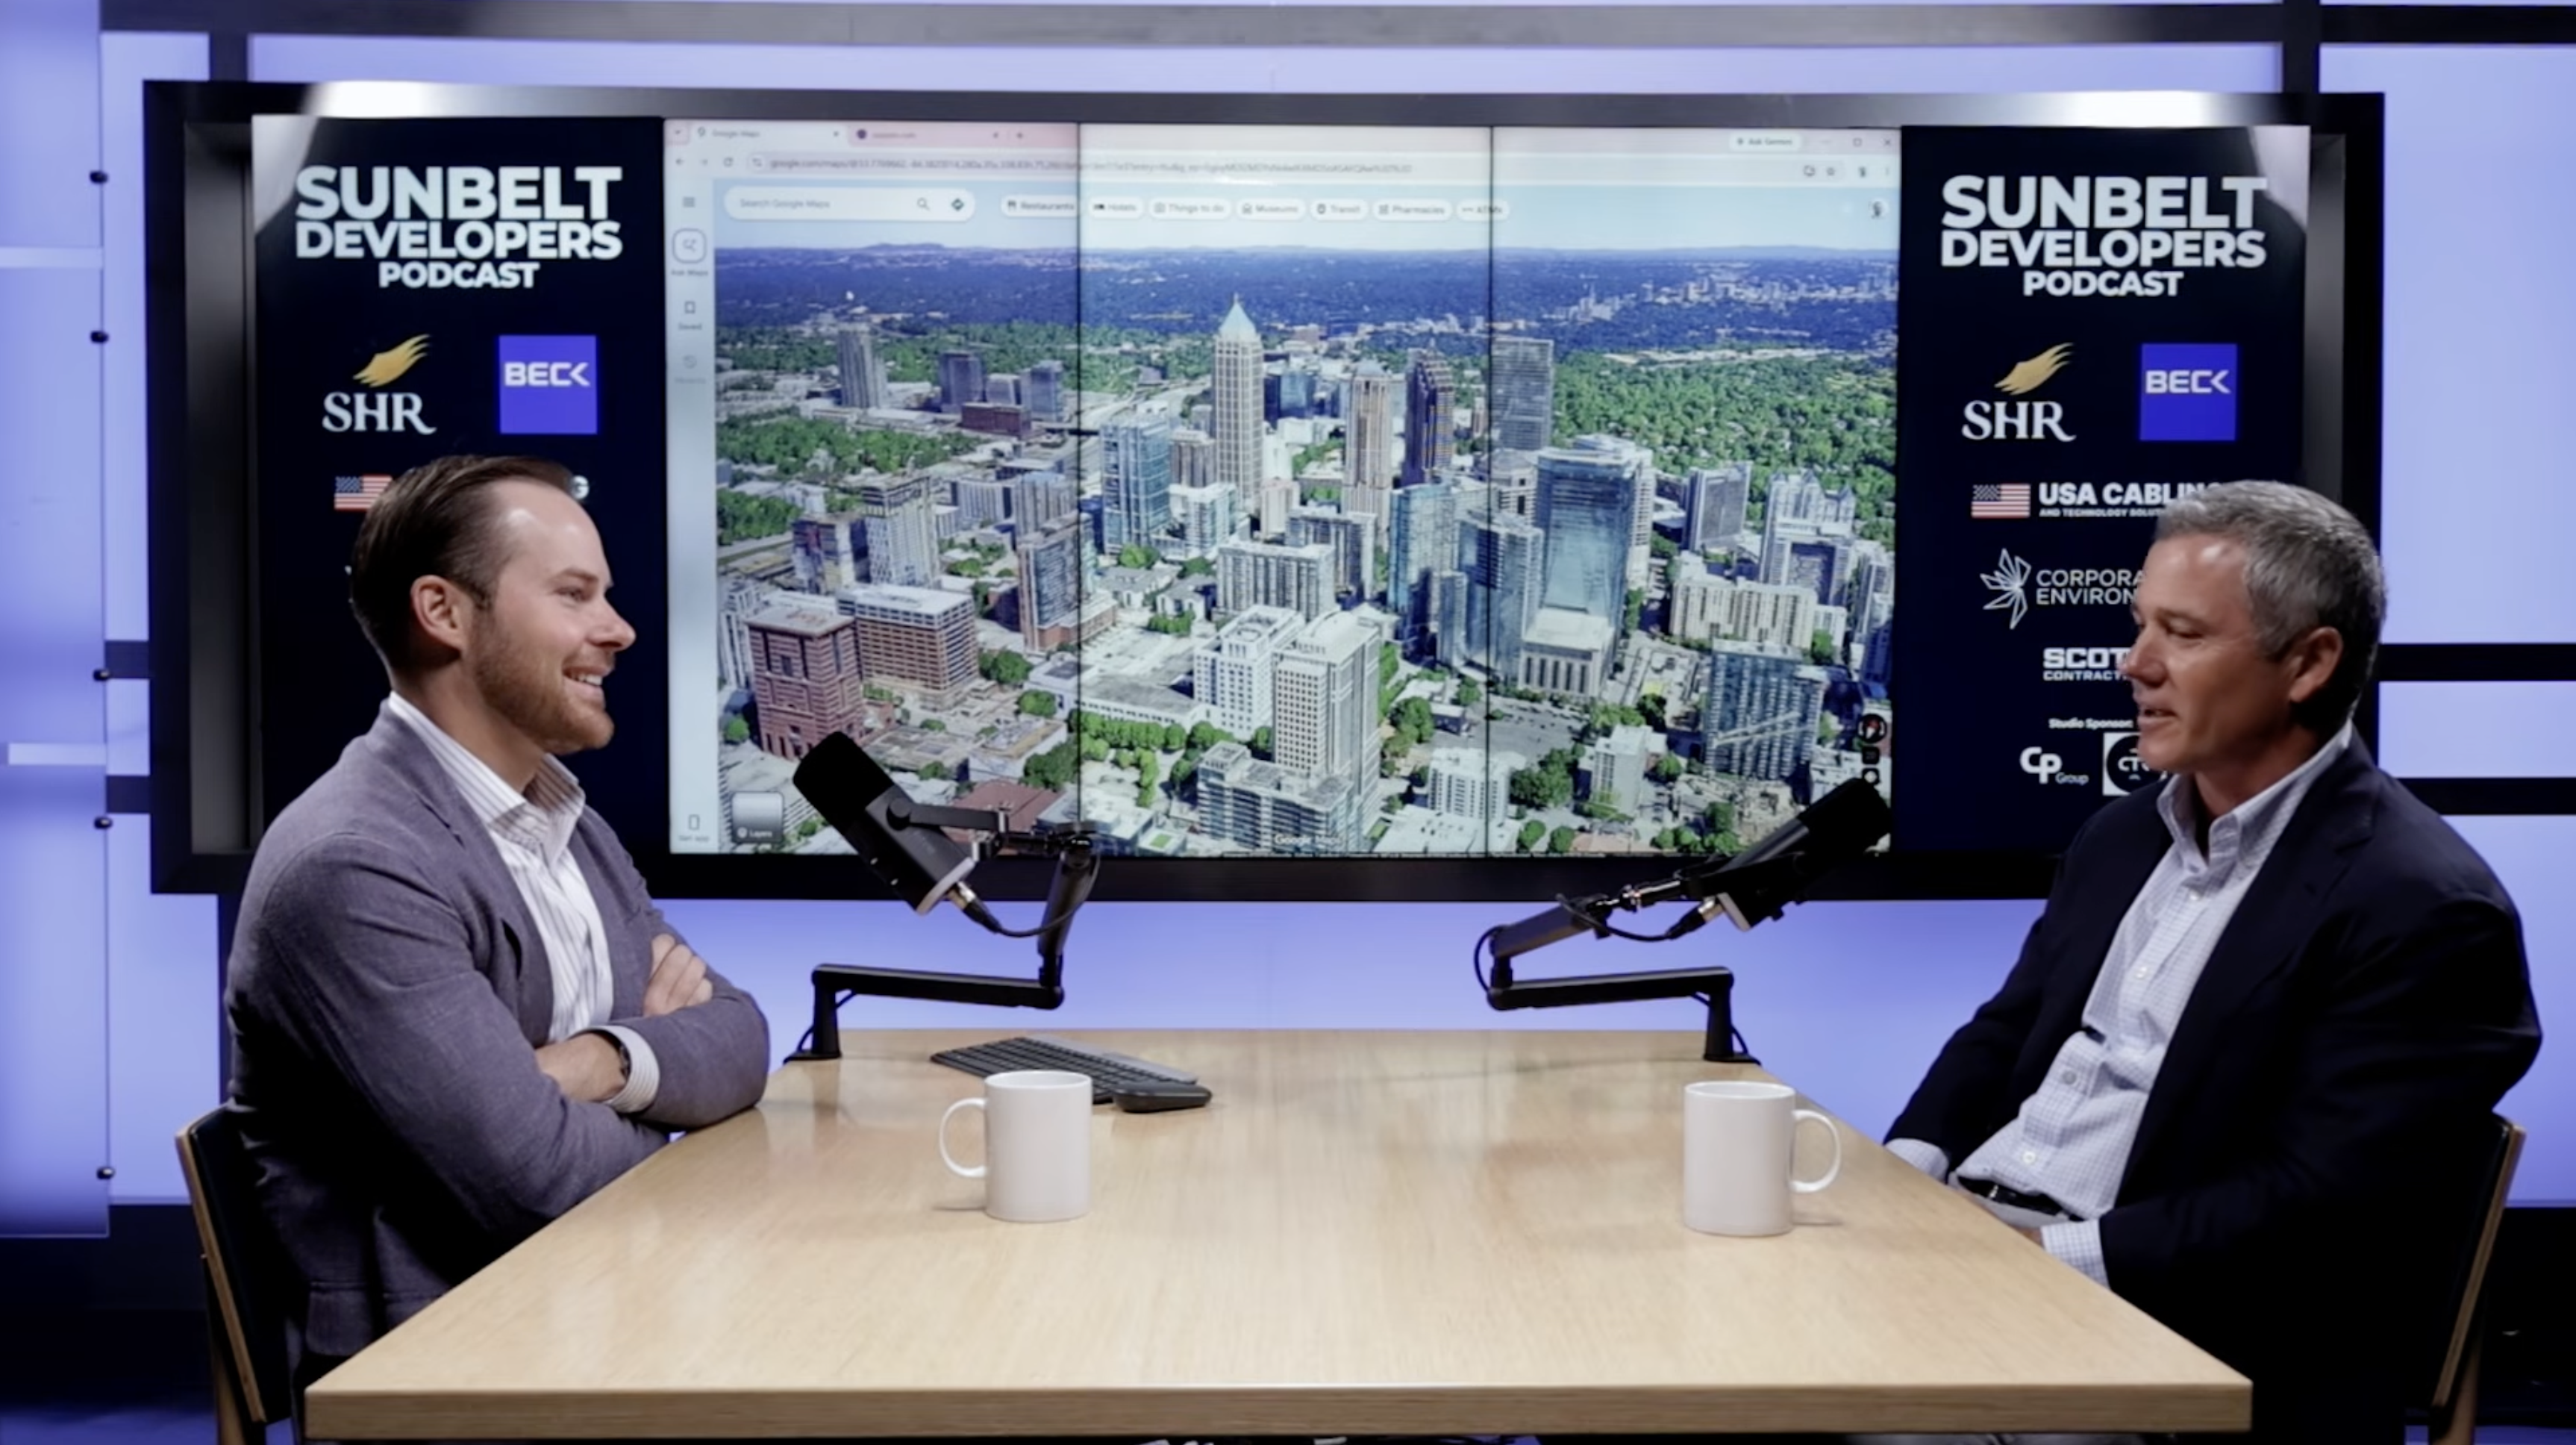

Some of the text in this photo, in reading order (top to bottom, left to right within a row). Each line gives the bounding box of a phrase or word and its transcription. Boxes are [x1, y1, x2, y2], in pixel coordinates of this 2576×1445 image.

[296, 166, 622, 219] SUNBELT
[740, 198, 830, 210] Search Google Maps
[1020, 201, 1075, 211] Restaurants
[1107, 203, 1137, 212] Hotels
[1168, 204, 1198, 214] Things
[1212, 204, 1223, 213] do
[1255, 205, 1298, 213] Museums
[1331, 205, 1360, 213] Transit
[1942, 175, 2267, 228] SUNBELT
[296, 220, 622, 259] DEVELOPERS
[1941, 229, 2267, 267] DEVELOPERS
[379, 261, 540, 288] PODCAST
[2023, 270, 2183, 296] PODCAST
[504, 361, 590, 387] BECK
[2145, 369, 2231, 394] BECK
[322, 391, 437, 435] SHR
[1961, 400, 2078, 442] SHR
[2038, 482, 2222, 506] USA CABLI
[2039, 508, 2061, 517] AND
[2062, 508, 2128, 517] TECHNOLOGY
[2036, 569, 2145, 587] CORPORA
[2043, 670, 2127, 681] CONTRACT
[2048, 717, 2084, 729] Studio
[2055, 773, 2089, 786] Group
[749, 829, 773, 839] Layers
[1275, 833, 1312, 847] Google
